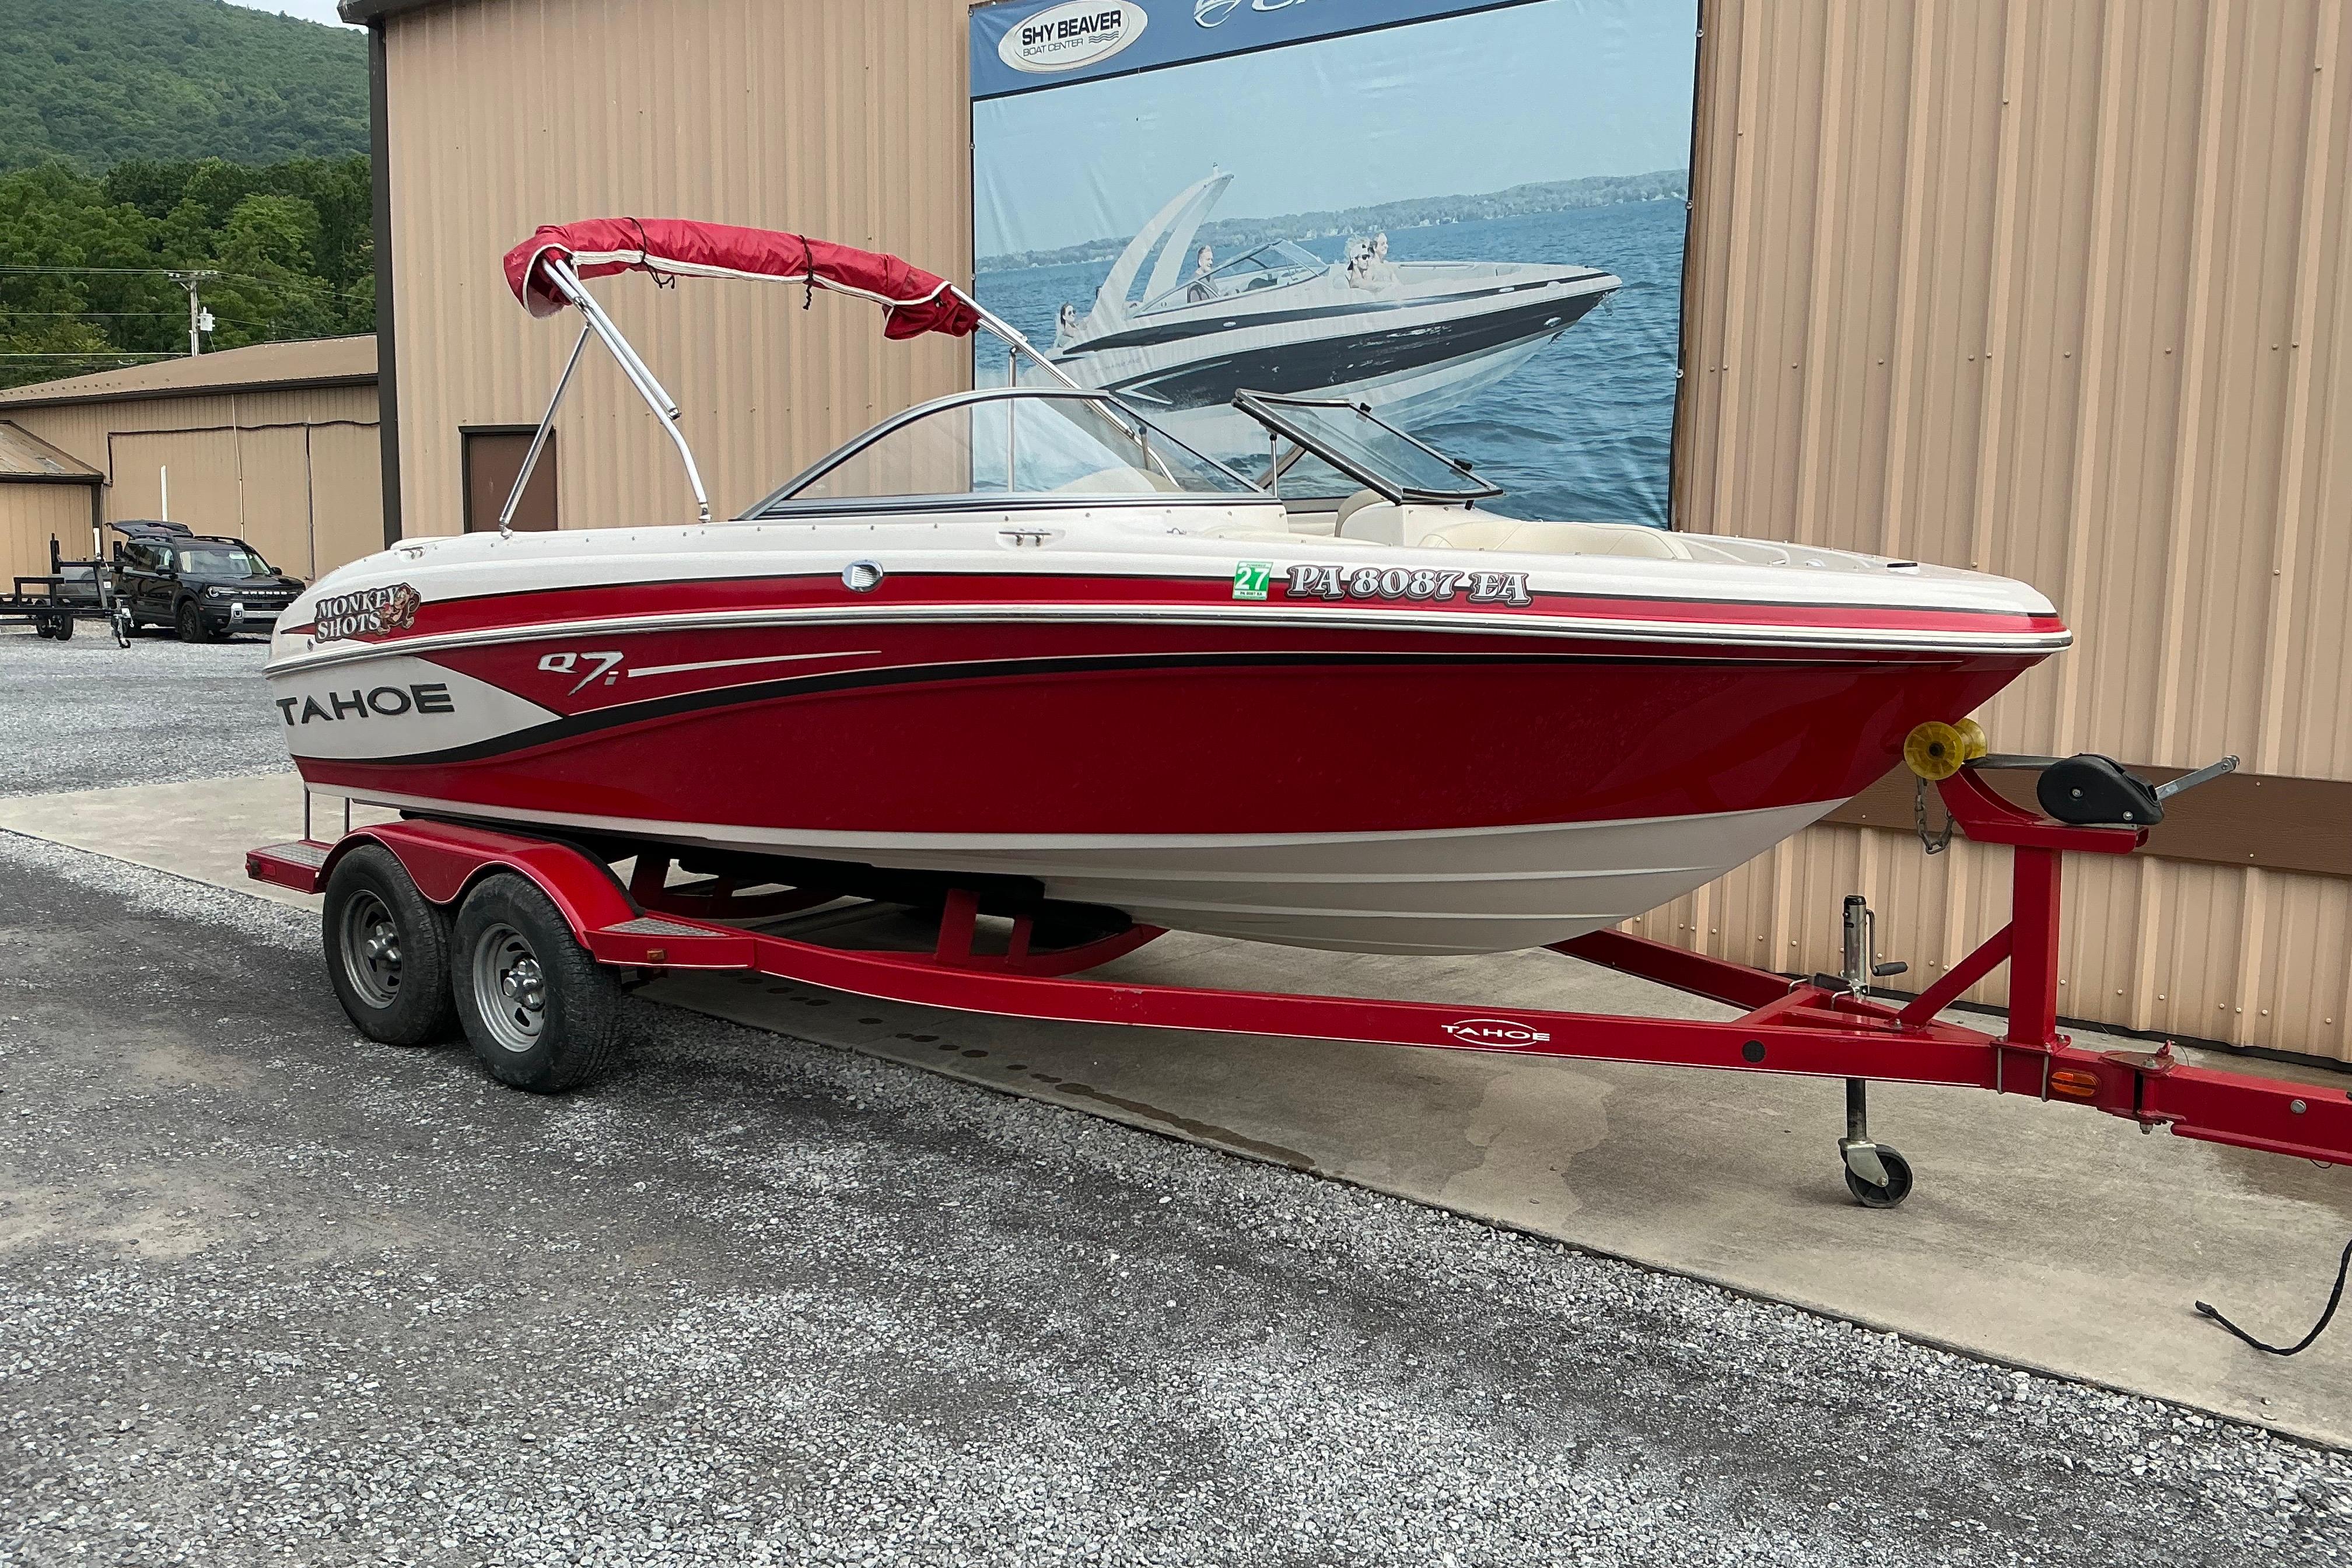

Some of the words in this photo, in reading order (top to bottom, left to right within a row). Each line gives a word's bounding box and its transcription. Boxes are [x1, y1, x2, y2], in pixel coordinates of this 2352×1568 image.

[1022, 23, 1055, 46] SHY
[1058, 9, 1122, 39] BEAVER
[1023, 45, 1049, 57] BOAT
[1048, 38, 1083, 54] CENTER
[1234, 567, 1270, 590] 27
[1287, 565, 1343, 598] PA
[1350, 568, 1464, 600] 8087
[1468, 572, 1532, 606] EA
[317, 587, 399, 620] MONKEY
[317, 611, 380, 640] SHOTS
[276, 682, 455, 726] TAHOE
[1441, 1024, 1550, 1042] TAHOE
